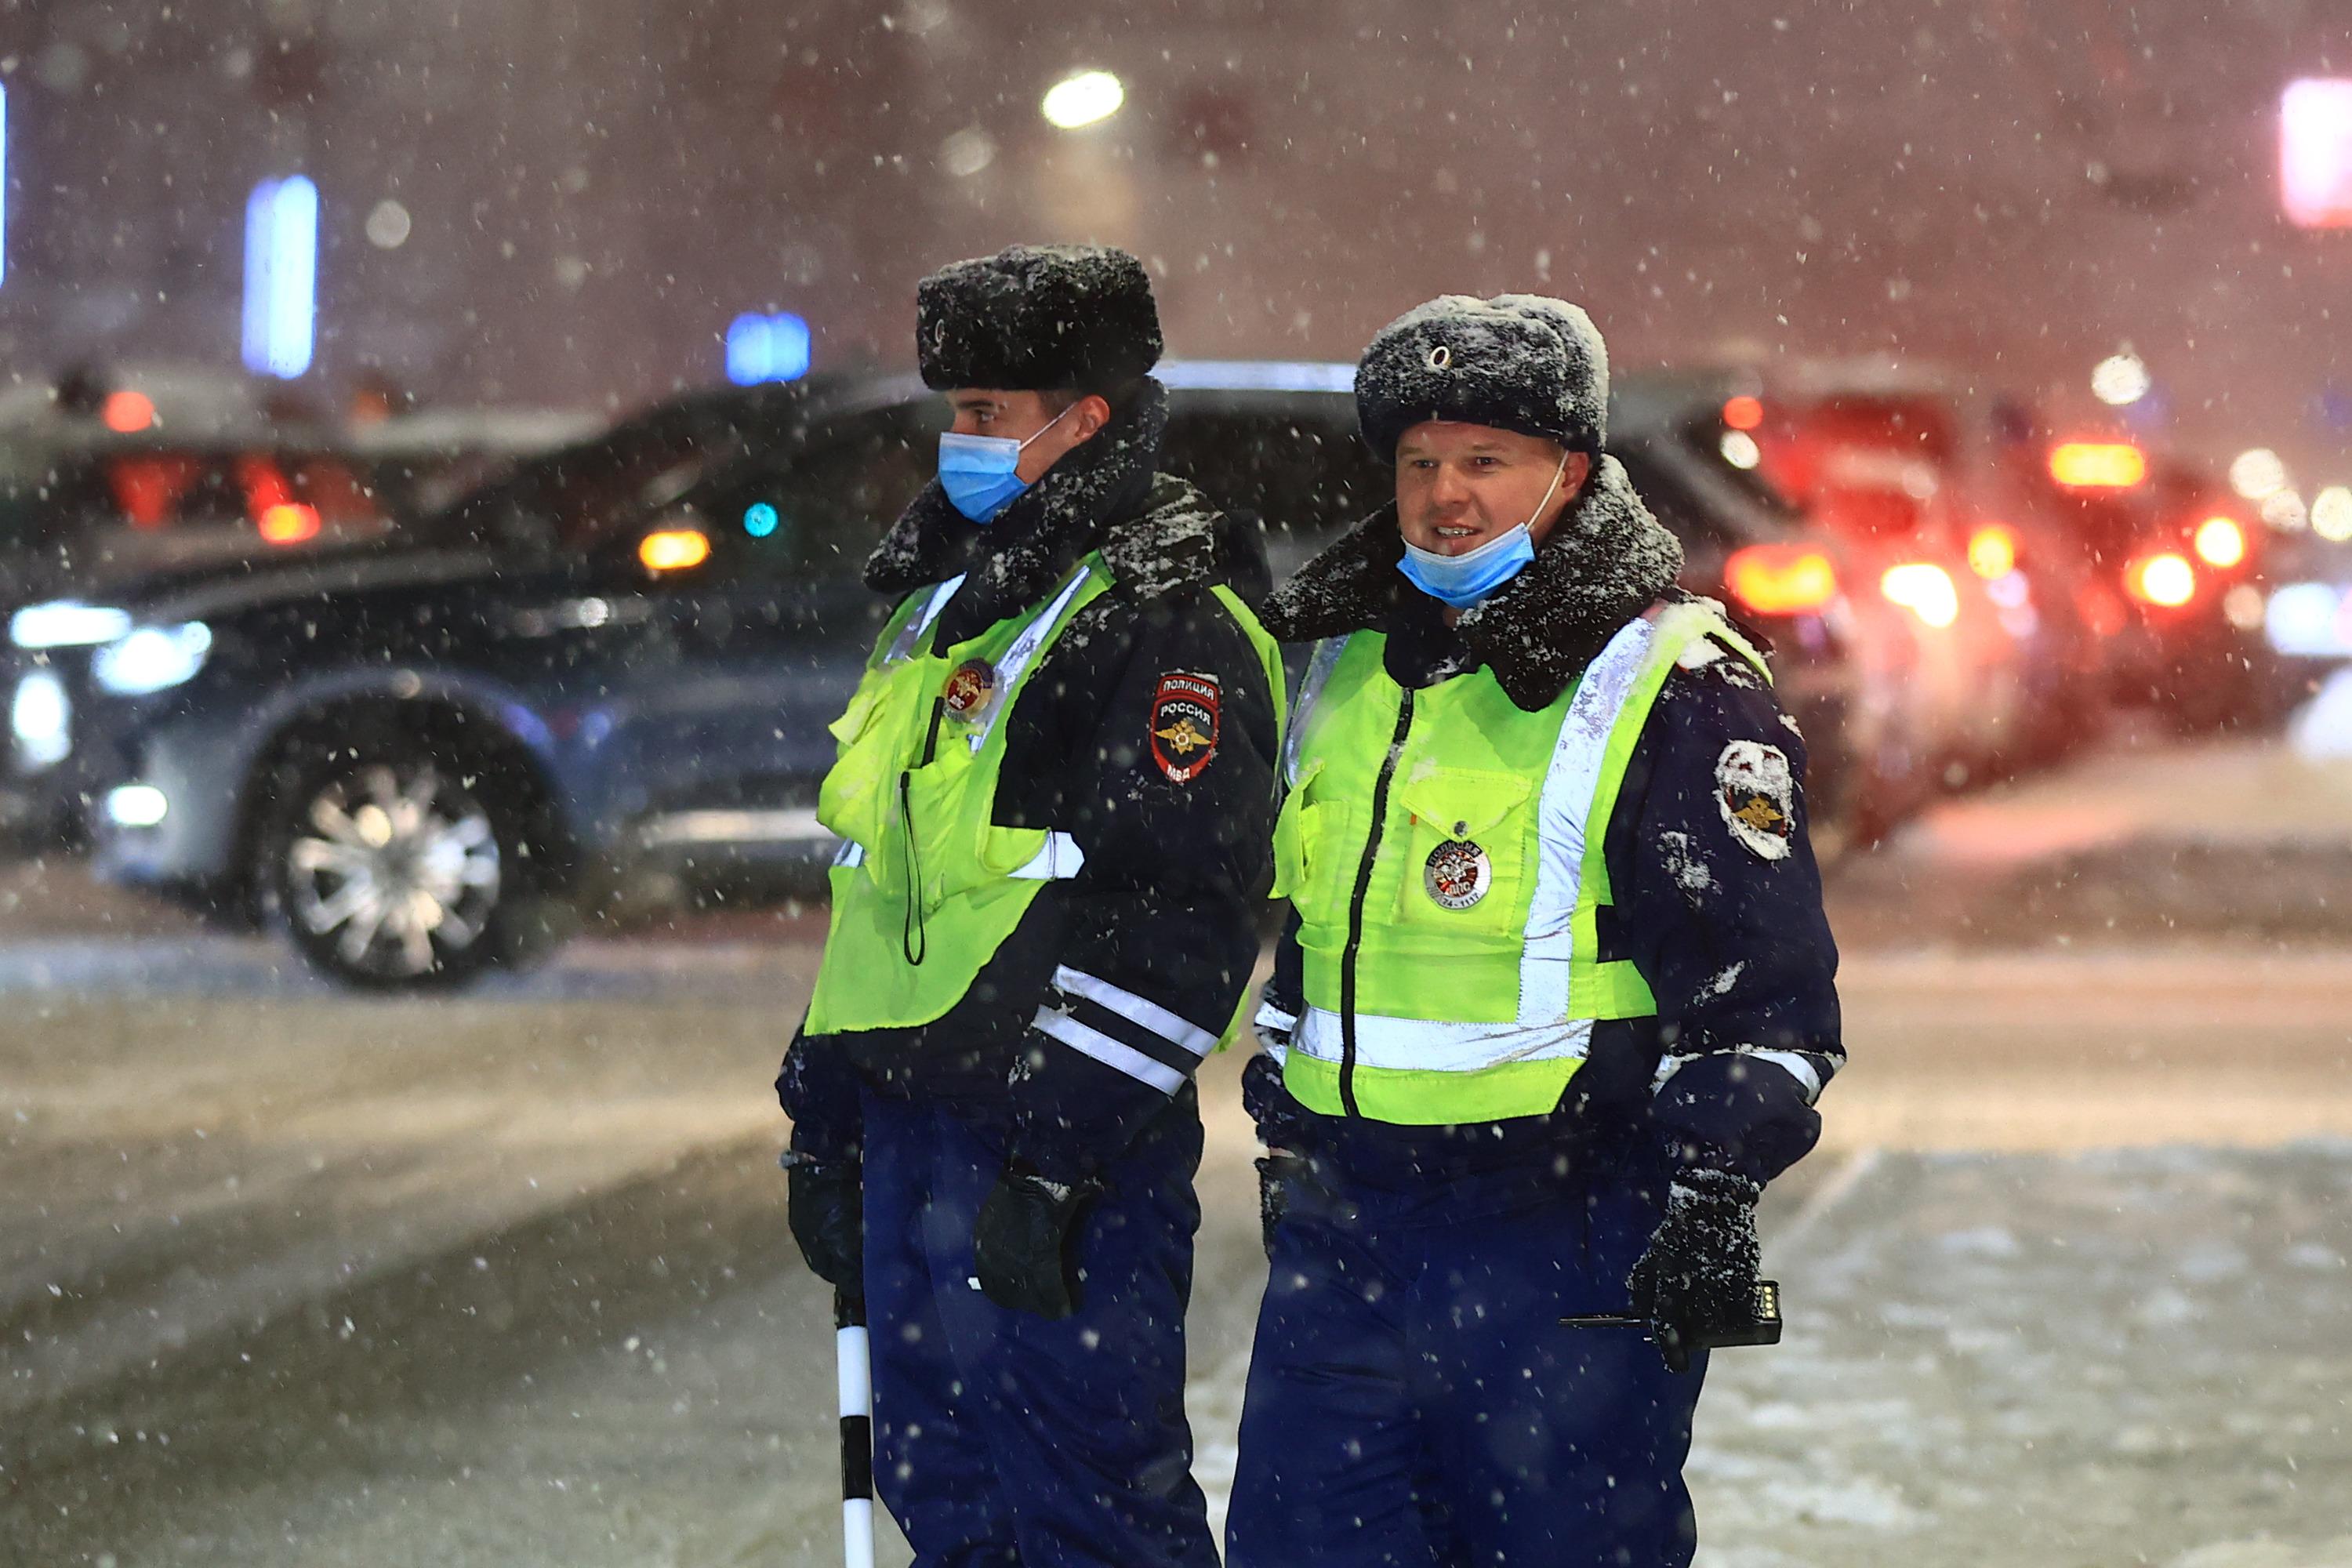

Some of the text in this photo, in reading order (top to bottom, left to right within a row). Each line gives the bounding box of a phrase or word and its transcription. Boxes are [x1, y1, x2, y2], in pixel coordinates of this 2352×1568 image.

[1163, 680, 1214, 700] ПОЛИЦИЯ
[1160, 702, 1210, 725] РОССИЯ
[1167, 764, 1190, 782] МВД
[1428, 842, 1480, 866] ПОЛИЦИЯ
